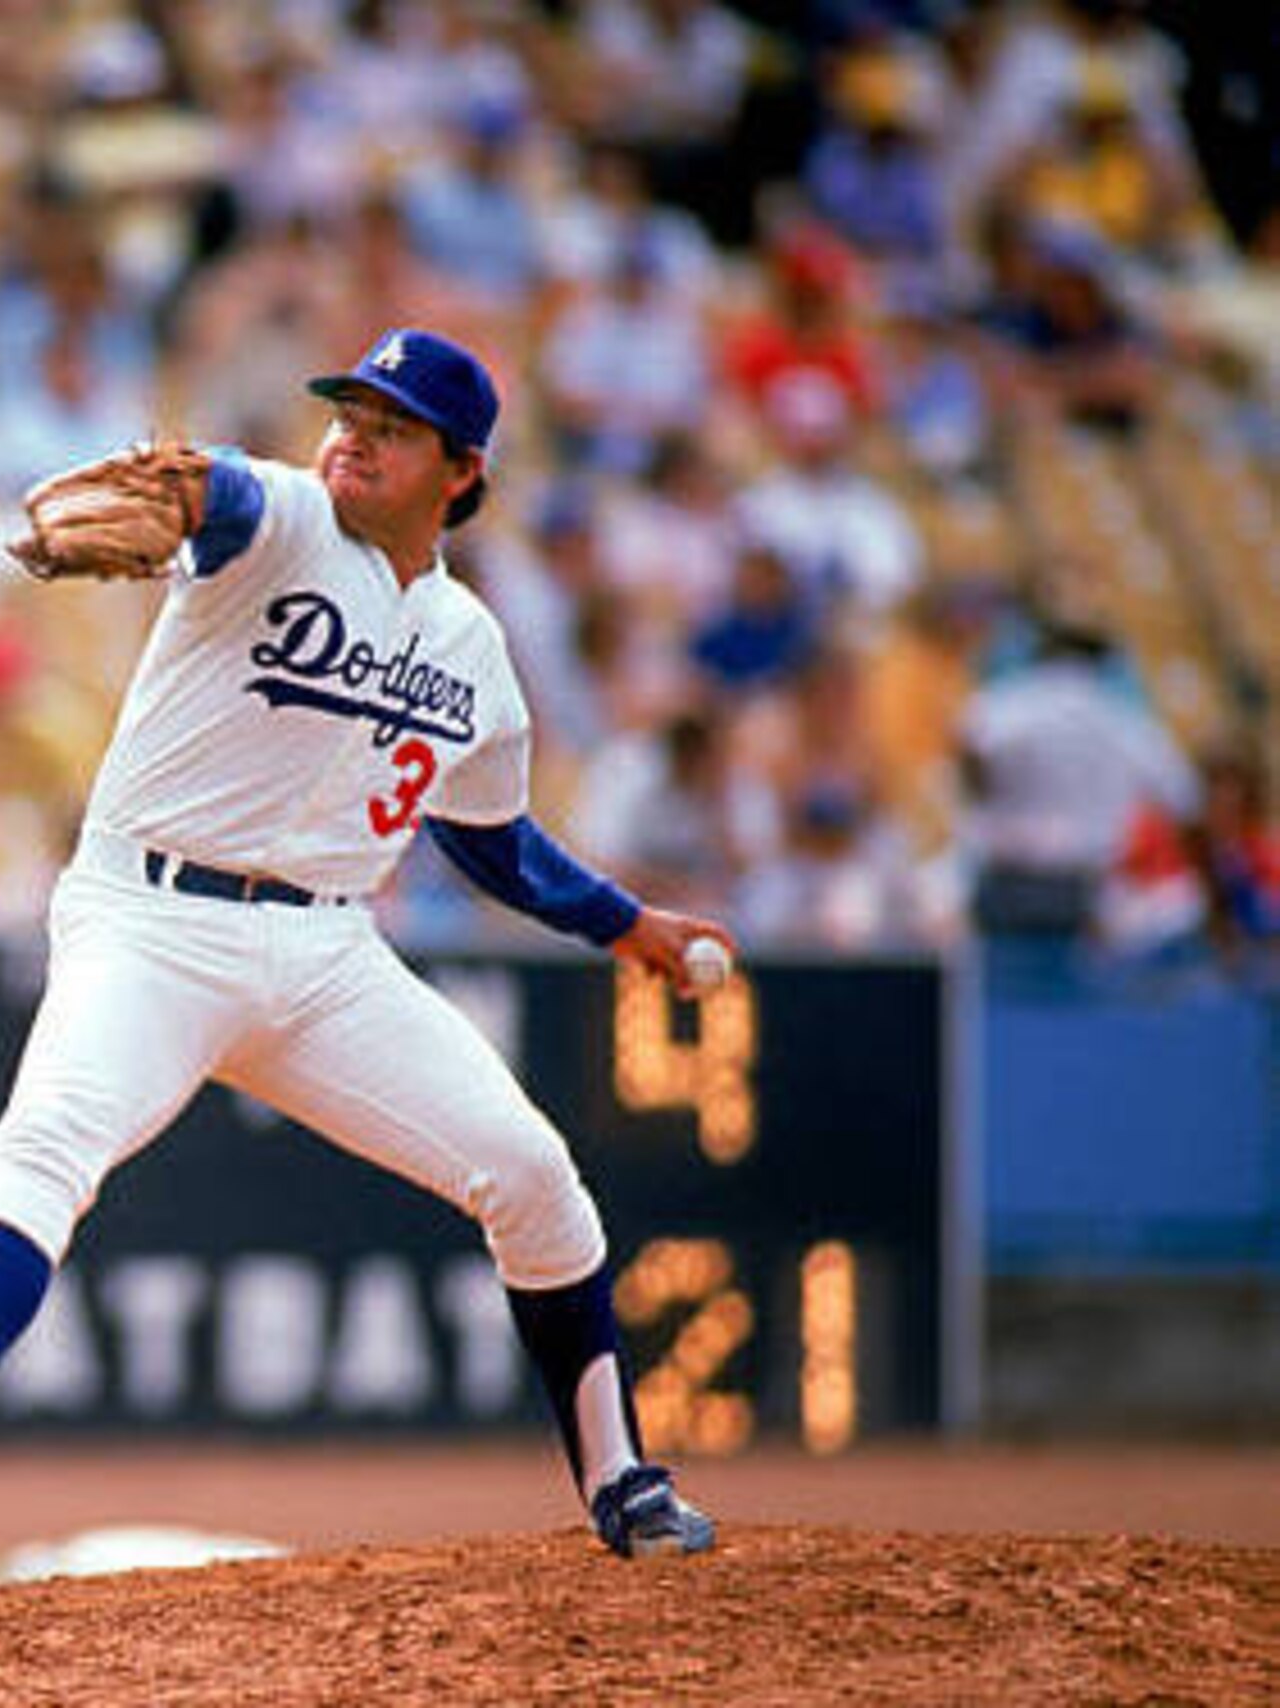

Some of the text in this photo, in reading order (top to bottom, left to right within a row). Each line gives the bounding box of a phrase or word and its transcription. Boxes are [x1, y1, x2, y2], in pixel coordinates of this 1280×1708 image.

[250, 592, 475, 748] Dodgers
[368, 739, 437, 838] 3
[613, 955, 755, 1163] 4
